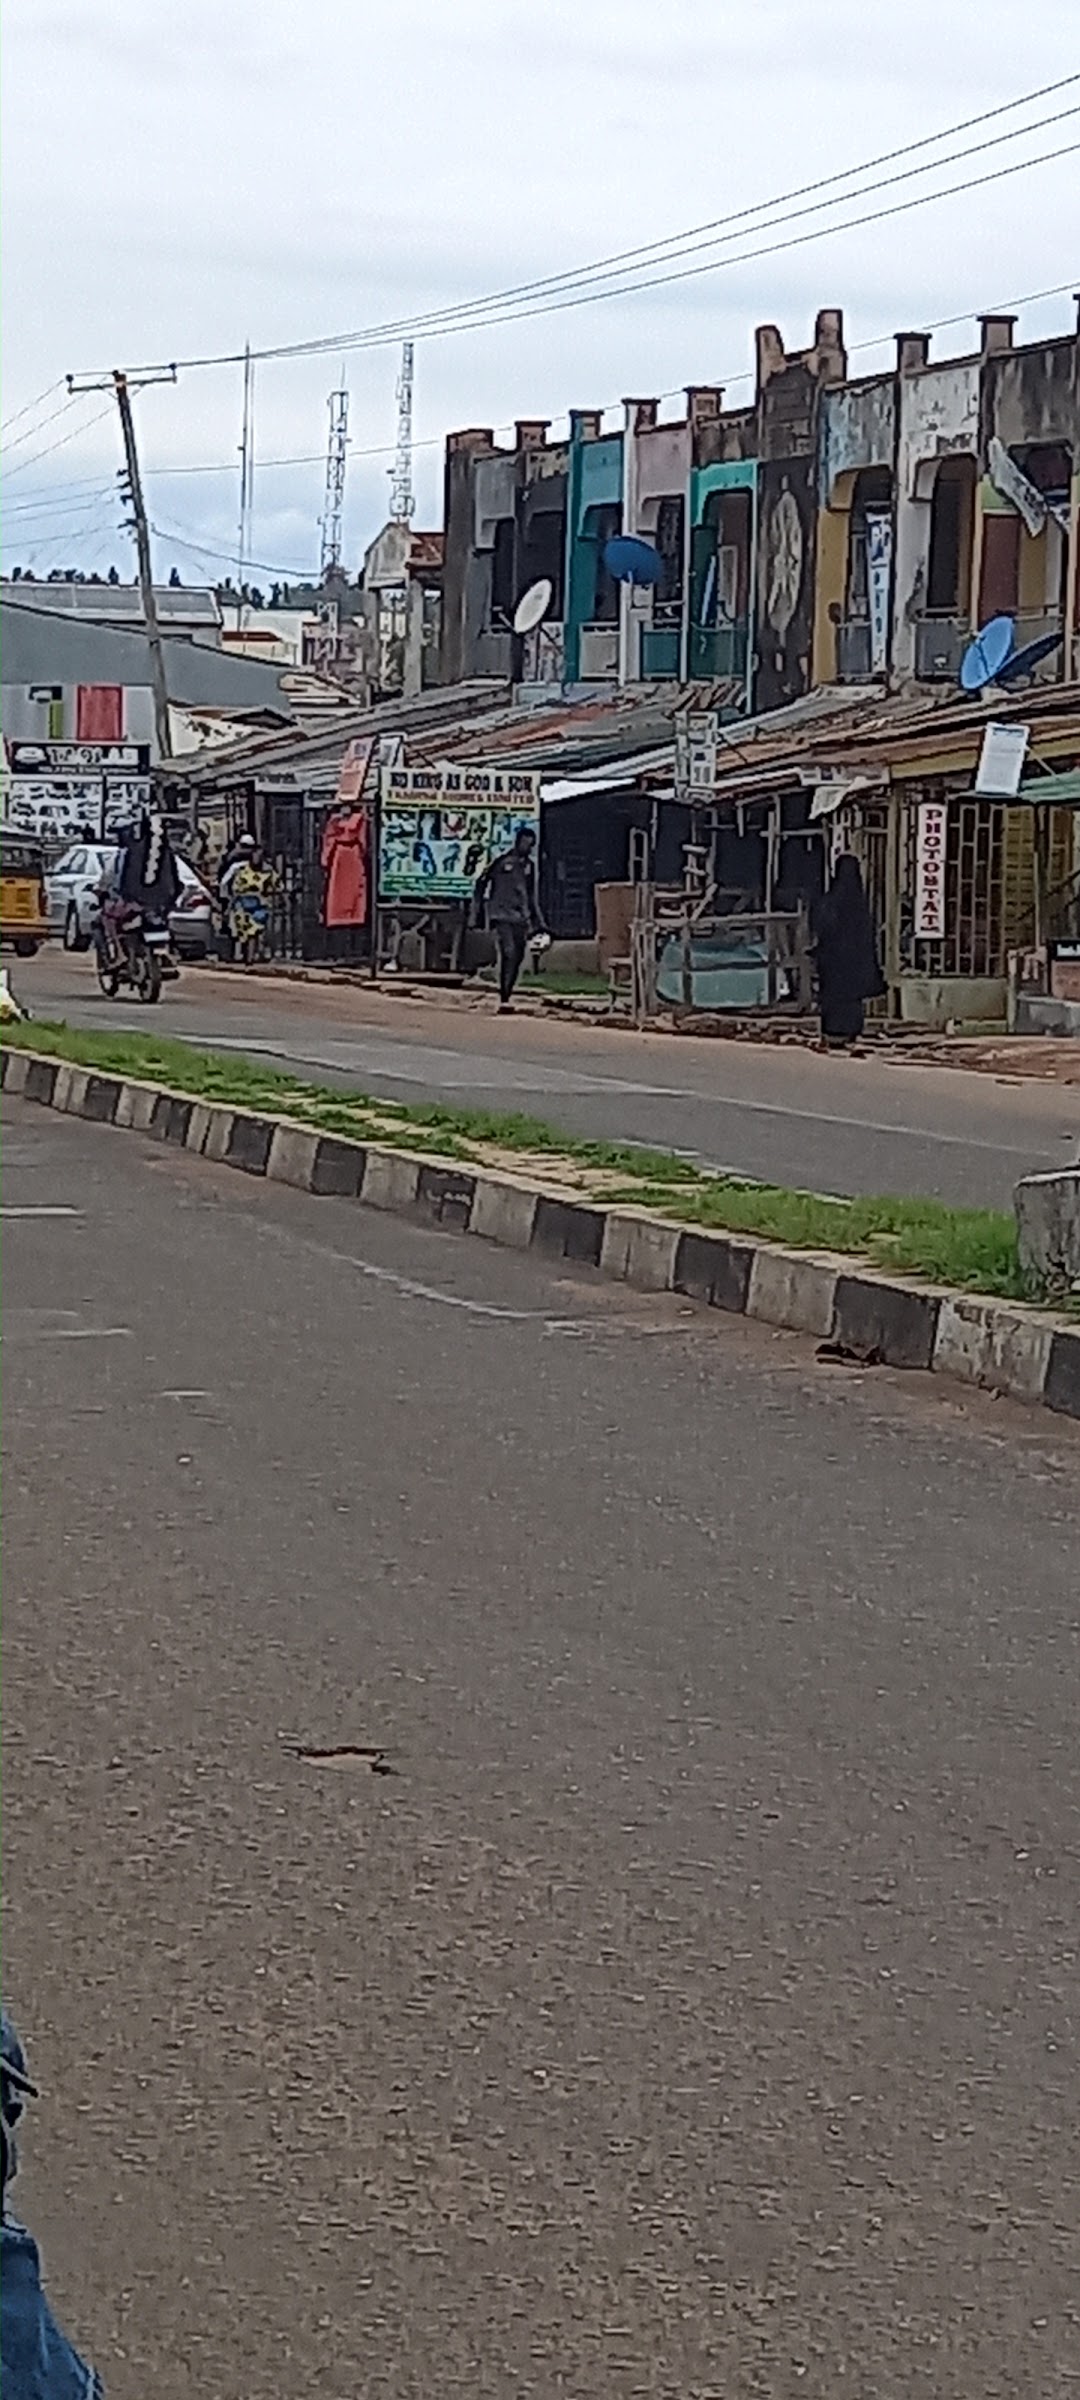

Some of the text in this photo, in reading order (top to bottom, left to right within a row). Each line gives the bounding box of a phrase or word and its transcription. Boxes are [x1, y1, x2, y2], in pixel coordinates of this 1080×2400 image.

[390, 772, 408, 788] NO
[412, 772, 442, 790] KING
[464, 773, 490, 790] GOD
[921, 808, 943, 926] PHOTOSTAT
